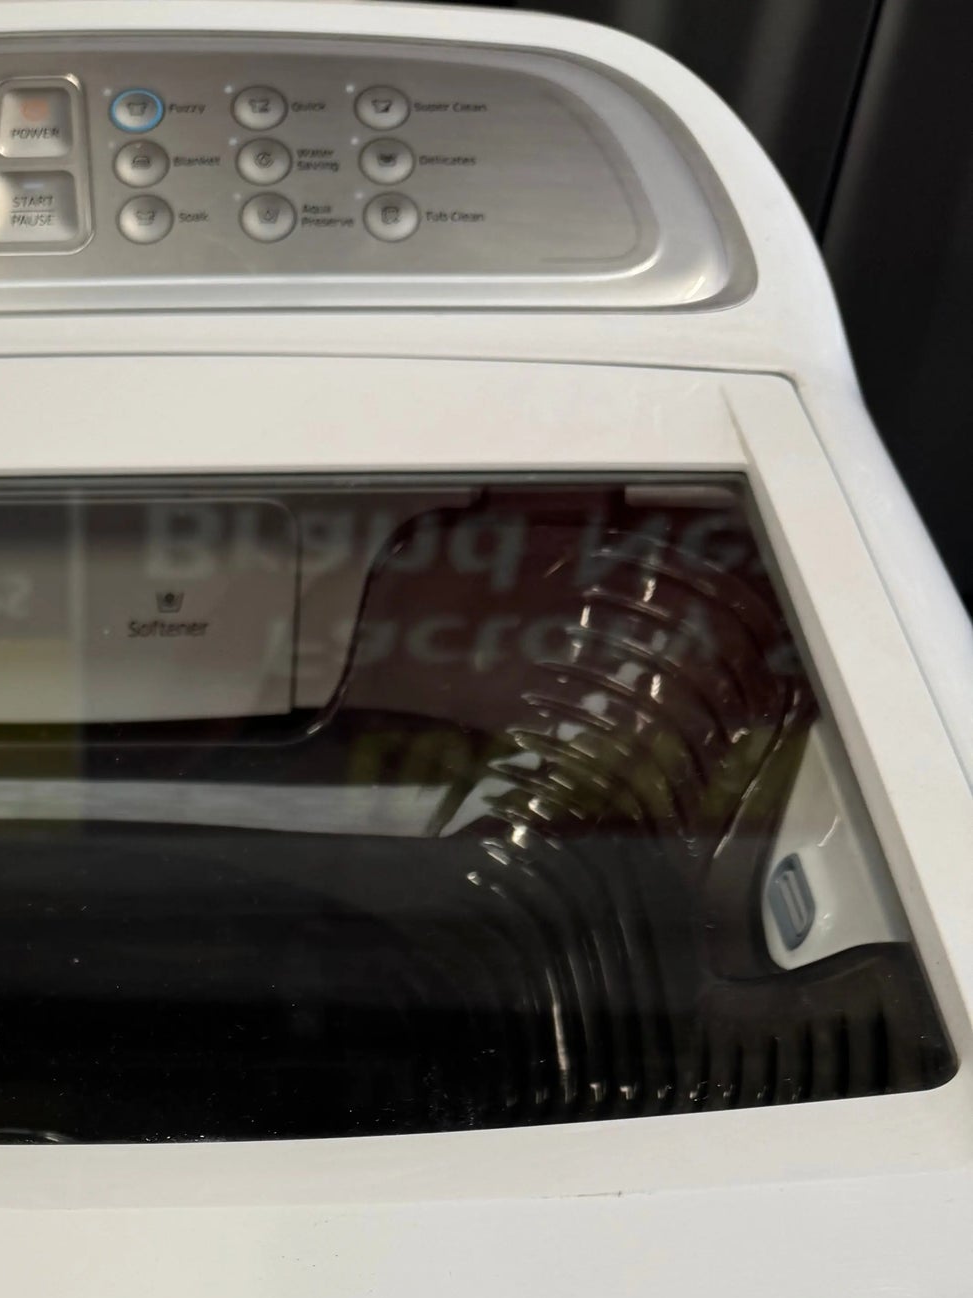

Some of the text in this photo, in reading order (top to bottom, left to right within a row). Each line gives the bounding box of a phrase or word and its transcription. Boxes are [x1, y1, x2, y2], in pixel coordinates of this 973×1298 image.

[11, 127, 60, 139] POWER
[11, 196, 53, 208] START
[10, 214, 54, 226] PAUSE
[128, 620, 210, 637] Softener
